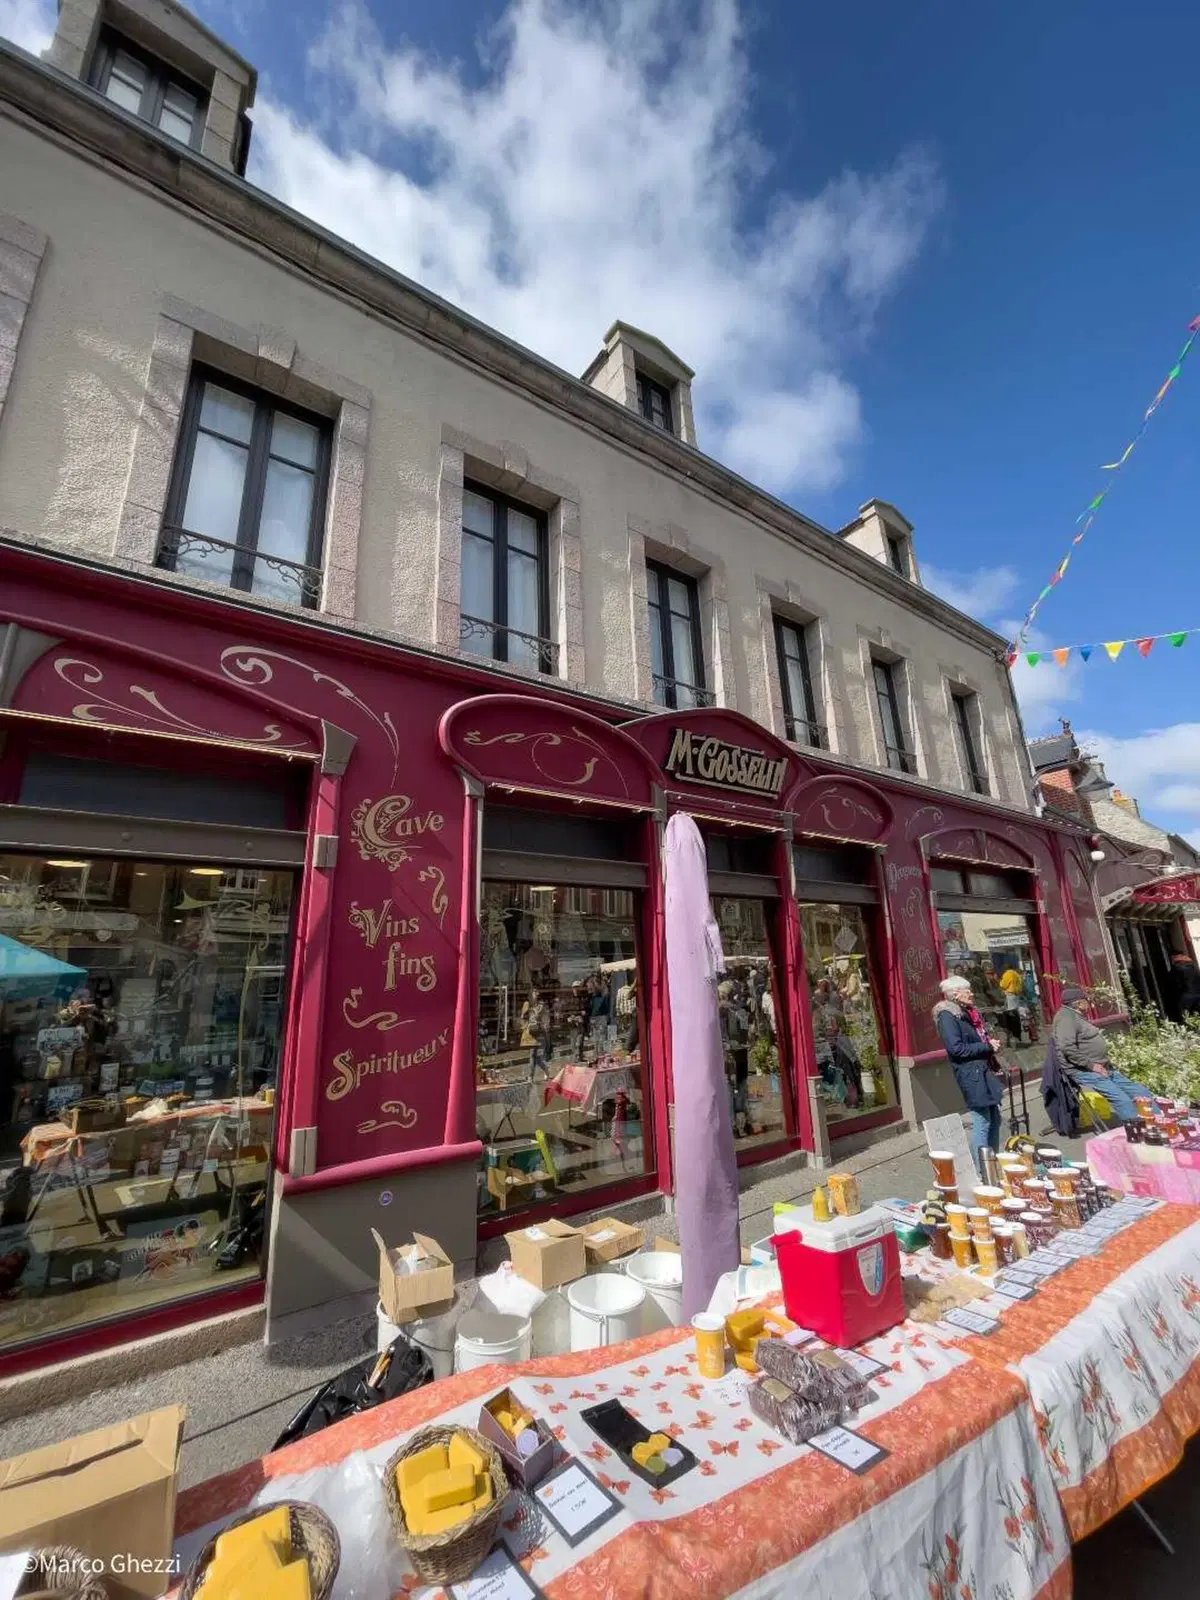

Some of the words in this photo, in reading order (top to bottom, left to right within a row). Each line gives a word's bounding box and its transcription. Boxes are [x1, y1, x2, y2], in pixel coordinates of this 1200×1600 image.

[353, 795, 444, 862] Cave
[350, 899, 420, 948] Vins
[382, 942, 437, 992] fins
[326, 1028, 448, 1101] Spiritueux
